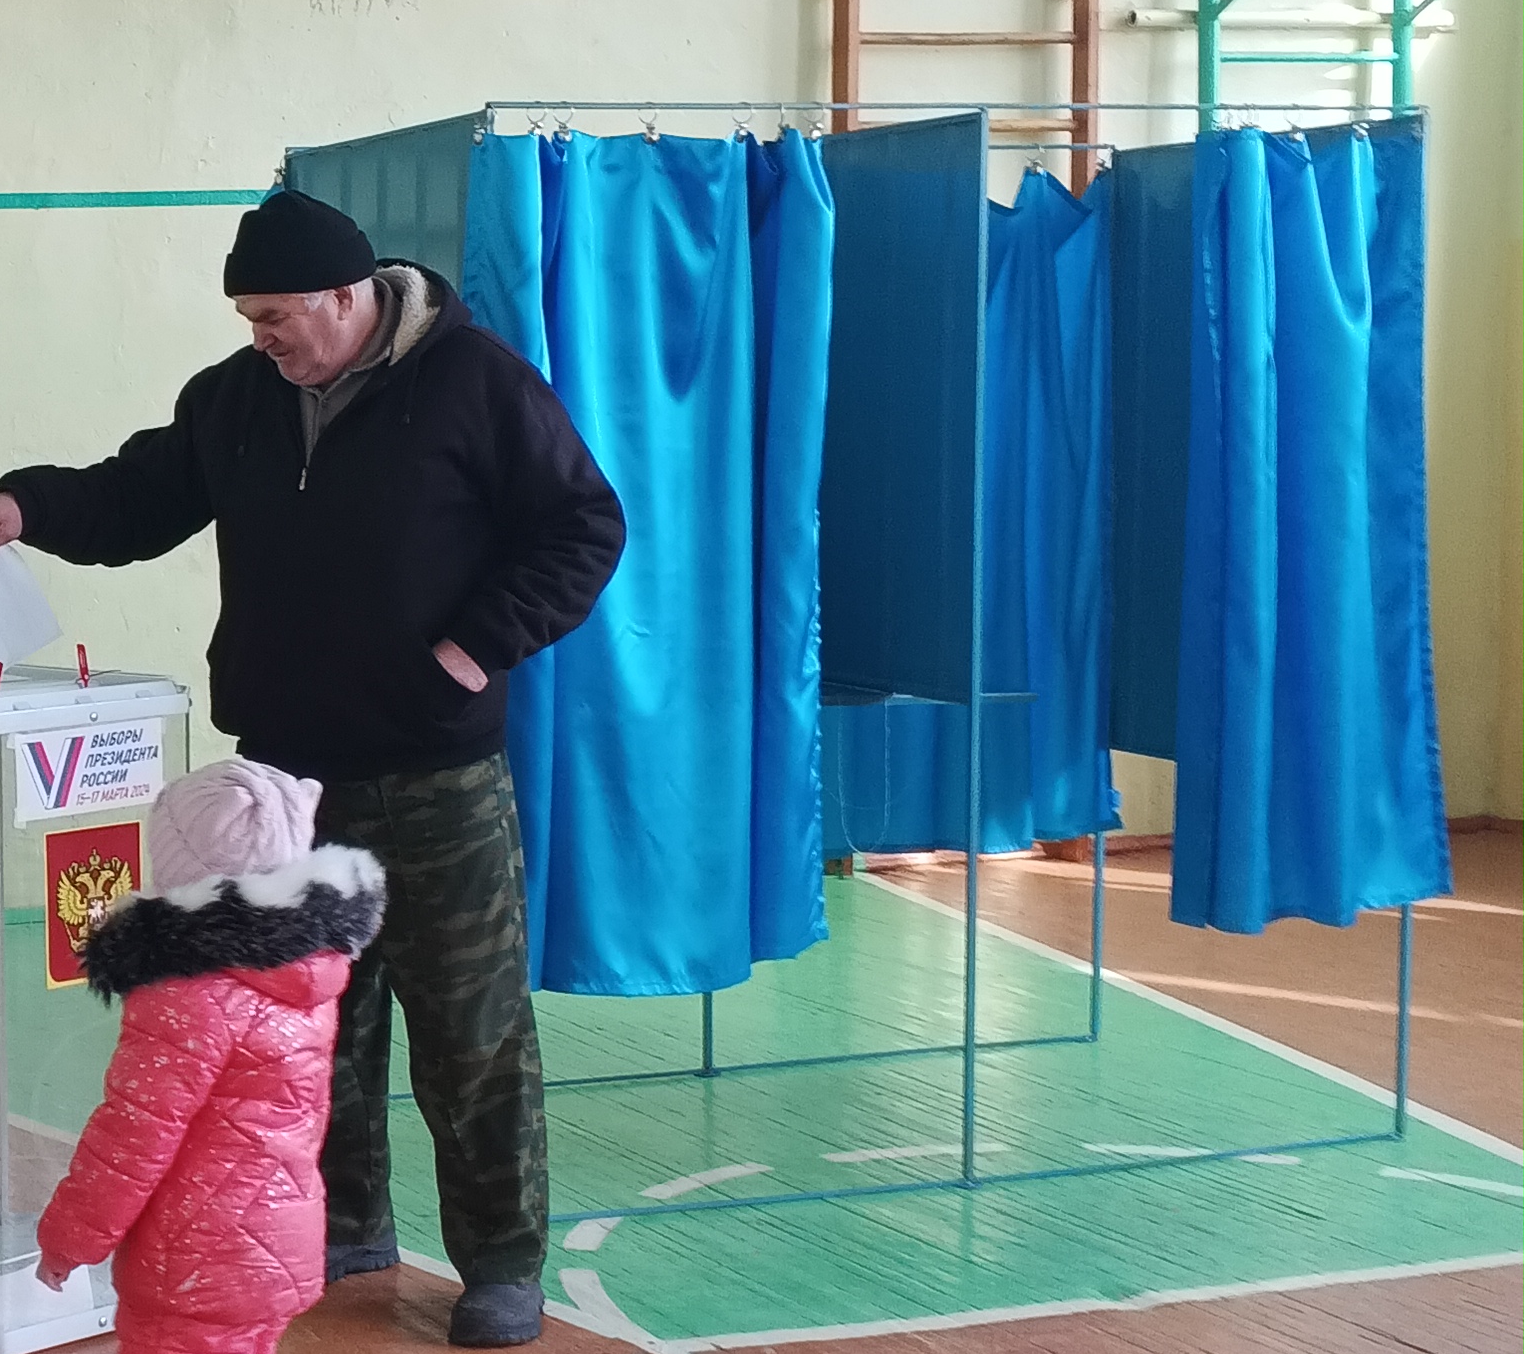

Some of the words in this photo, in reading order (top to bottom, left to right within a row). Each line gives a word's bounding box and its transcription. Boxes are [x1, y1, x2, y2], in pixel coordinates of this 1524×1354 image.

[90, 728, 144, 749] ВЫБОРЫ
[84, 745, 159, 769] ПРЕЗИДЕНТА
[79, 768, 129, 788] РОССИИ
[100, 786, 129, 802] МАРТА
